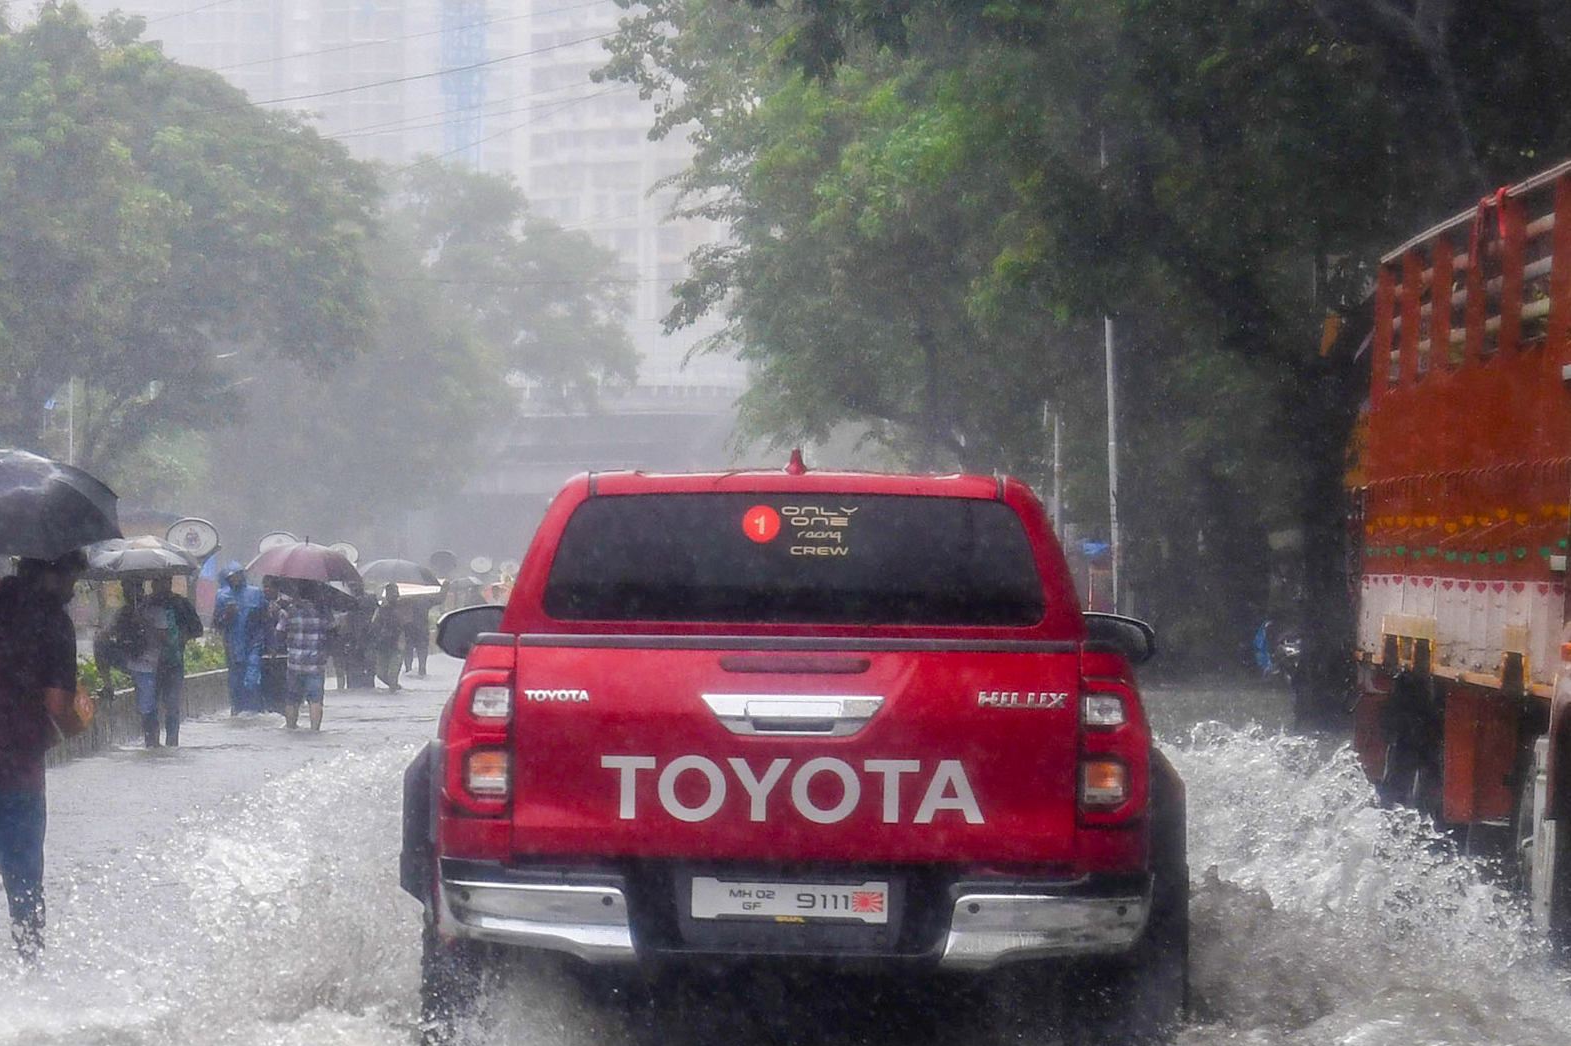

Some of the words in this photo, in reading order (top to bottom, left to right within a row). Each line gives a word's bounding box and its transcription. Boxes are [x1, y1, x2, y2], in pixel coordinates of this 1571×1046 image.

[790, 546, 849, 556] CREW
[524, 690, 589, 702] TOYOTA
[978, 691, 1068, 709] HILUX
[601, 754, 986, 824] TOYOTA
[728, 889, 753, 898] MH
[755, 889, 776, 899] 02
[742, 902, 762, 910] GF
[796, 893, 849, 910] 9111
